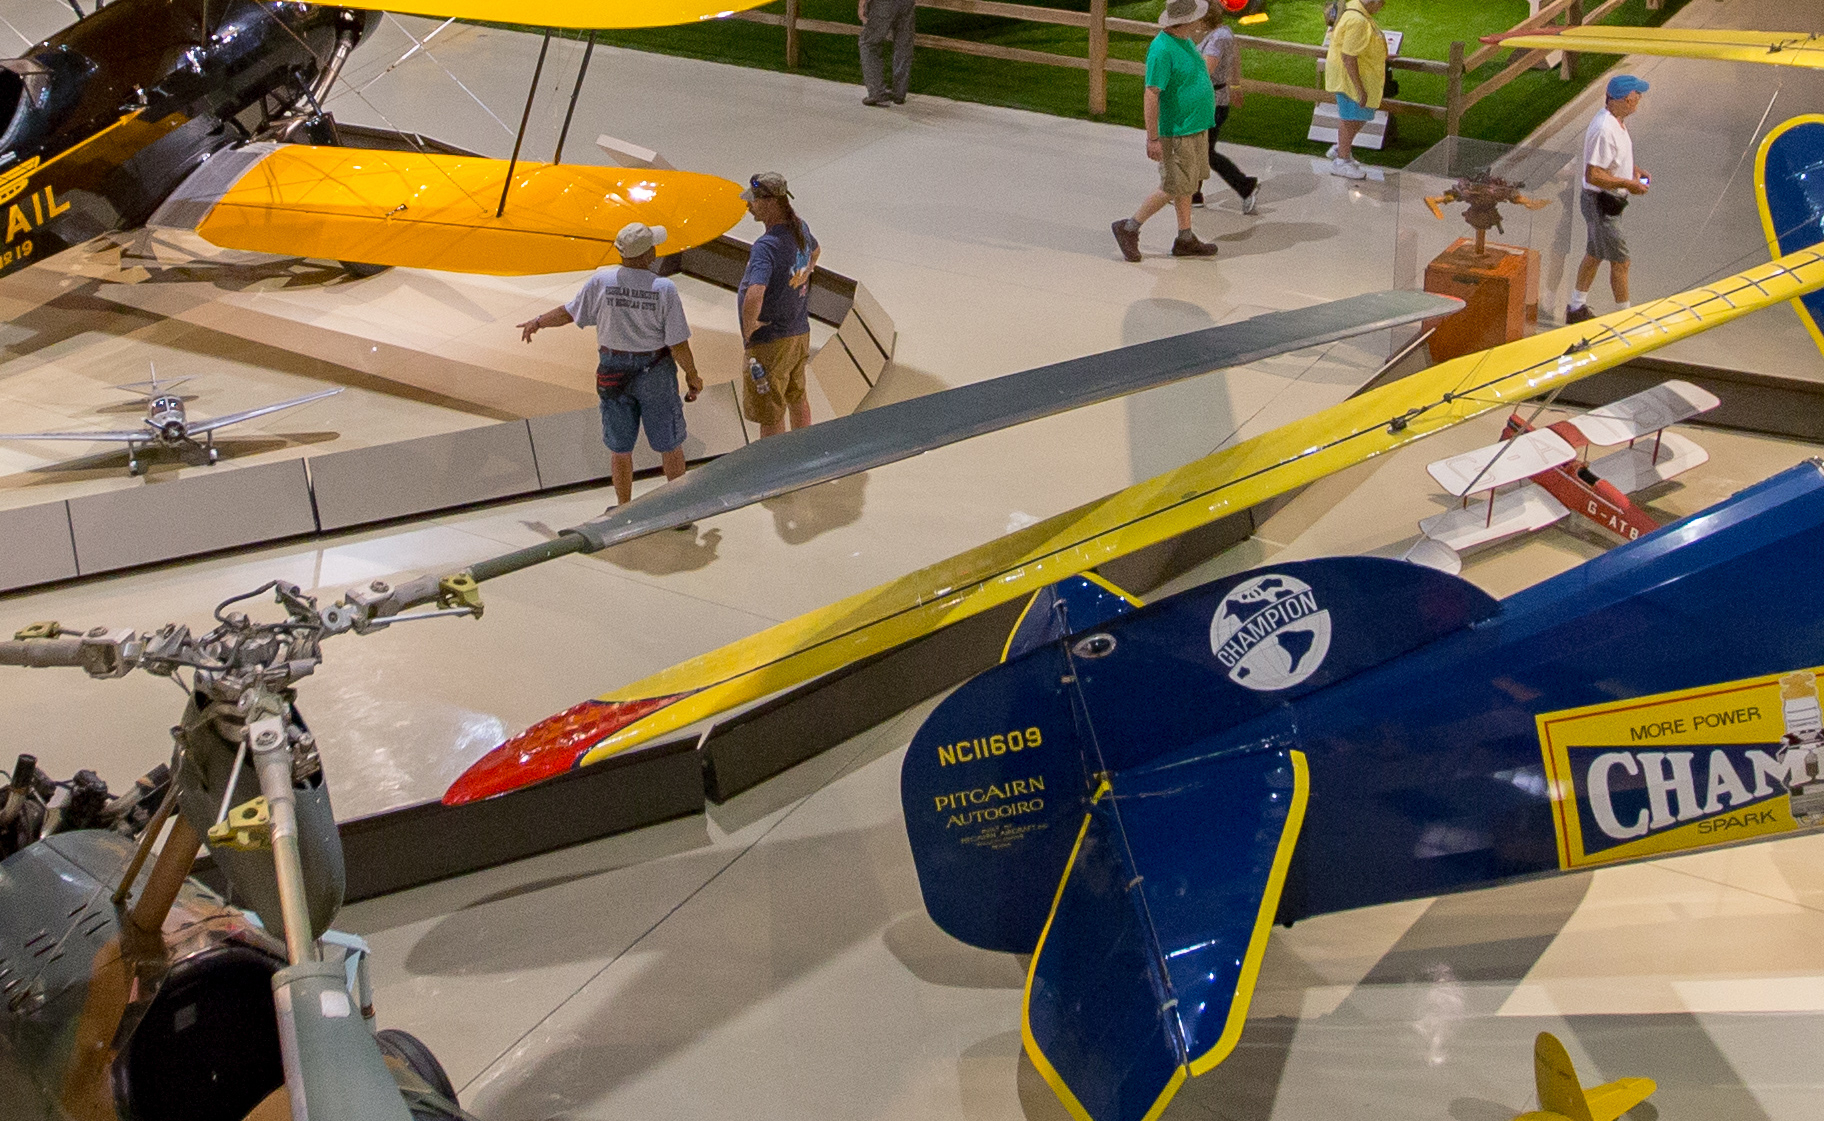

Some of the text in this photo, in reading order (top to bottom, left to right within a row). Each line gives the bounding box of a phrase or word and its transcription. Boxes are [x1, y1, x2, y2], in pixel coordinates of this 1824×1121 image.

[15, 239, 34, 260] 19
[1217, 590, 1318, 668] CHAMPION
[1630, 718, 1687, 742] MORE
[1693, 706, 1761, 731] POWER
[937, 726, 1043, 767] NC11609
[934, 775, 1046, 812] PITCAIRN
[1697, 809, 1777, 834] SPARK
